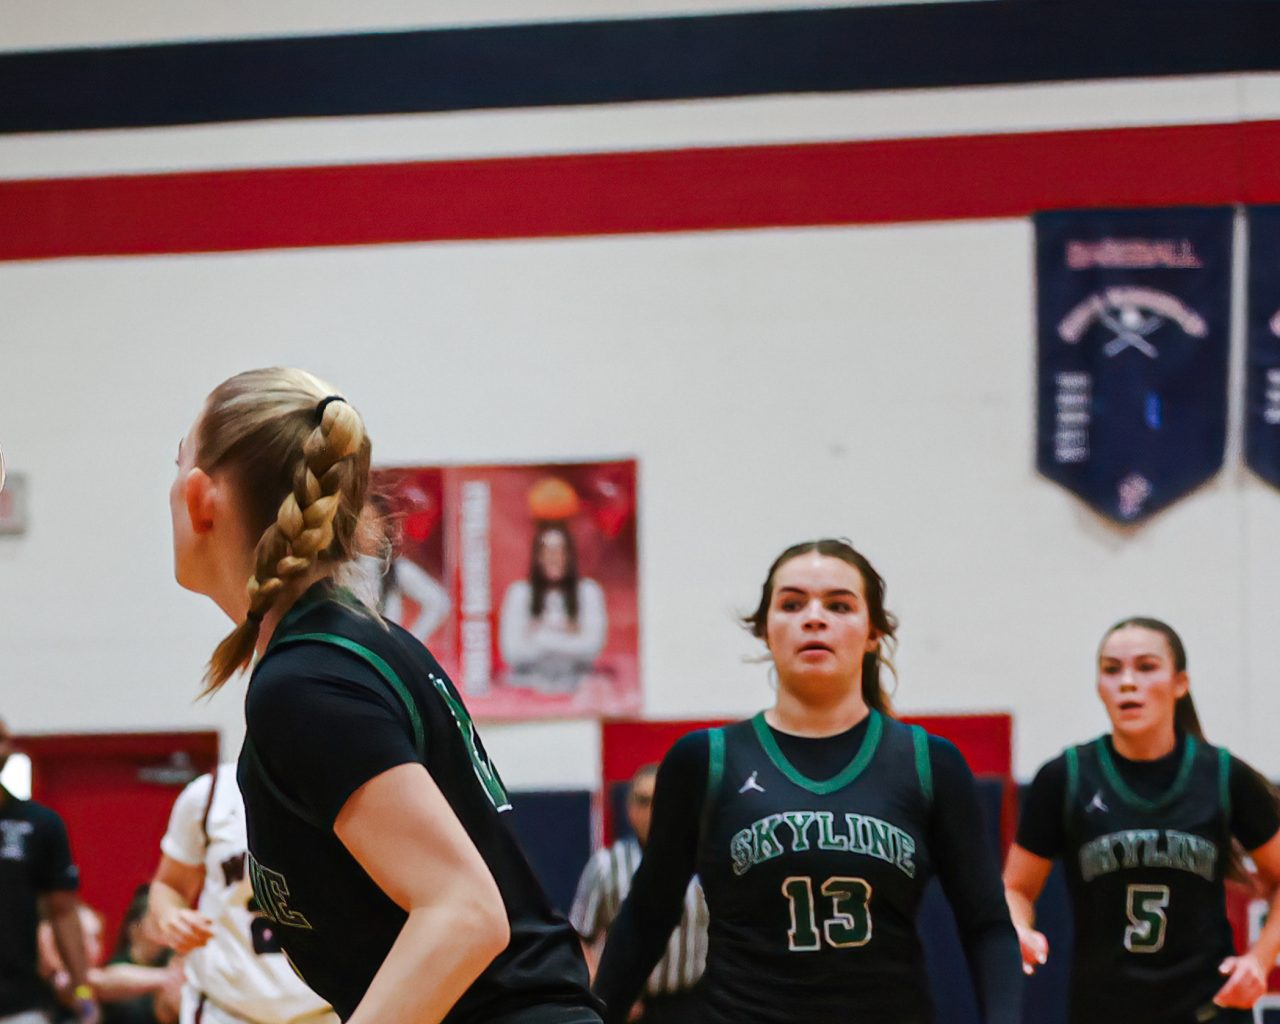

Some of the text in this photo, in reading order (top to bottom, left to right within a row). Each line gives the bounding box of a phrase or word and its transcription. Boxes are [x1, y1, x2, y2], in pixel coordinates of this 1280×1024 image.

[730, 811, 916, 879] SKYLINE
[1079, 828, 1218, 883] SKYLINE
[781, 876, 872, 951] 13
[1123, 883, 1170, 953] 5
